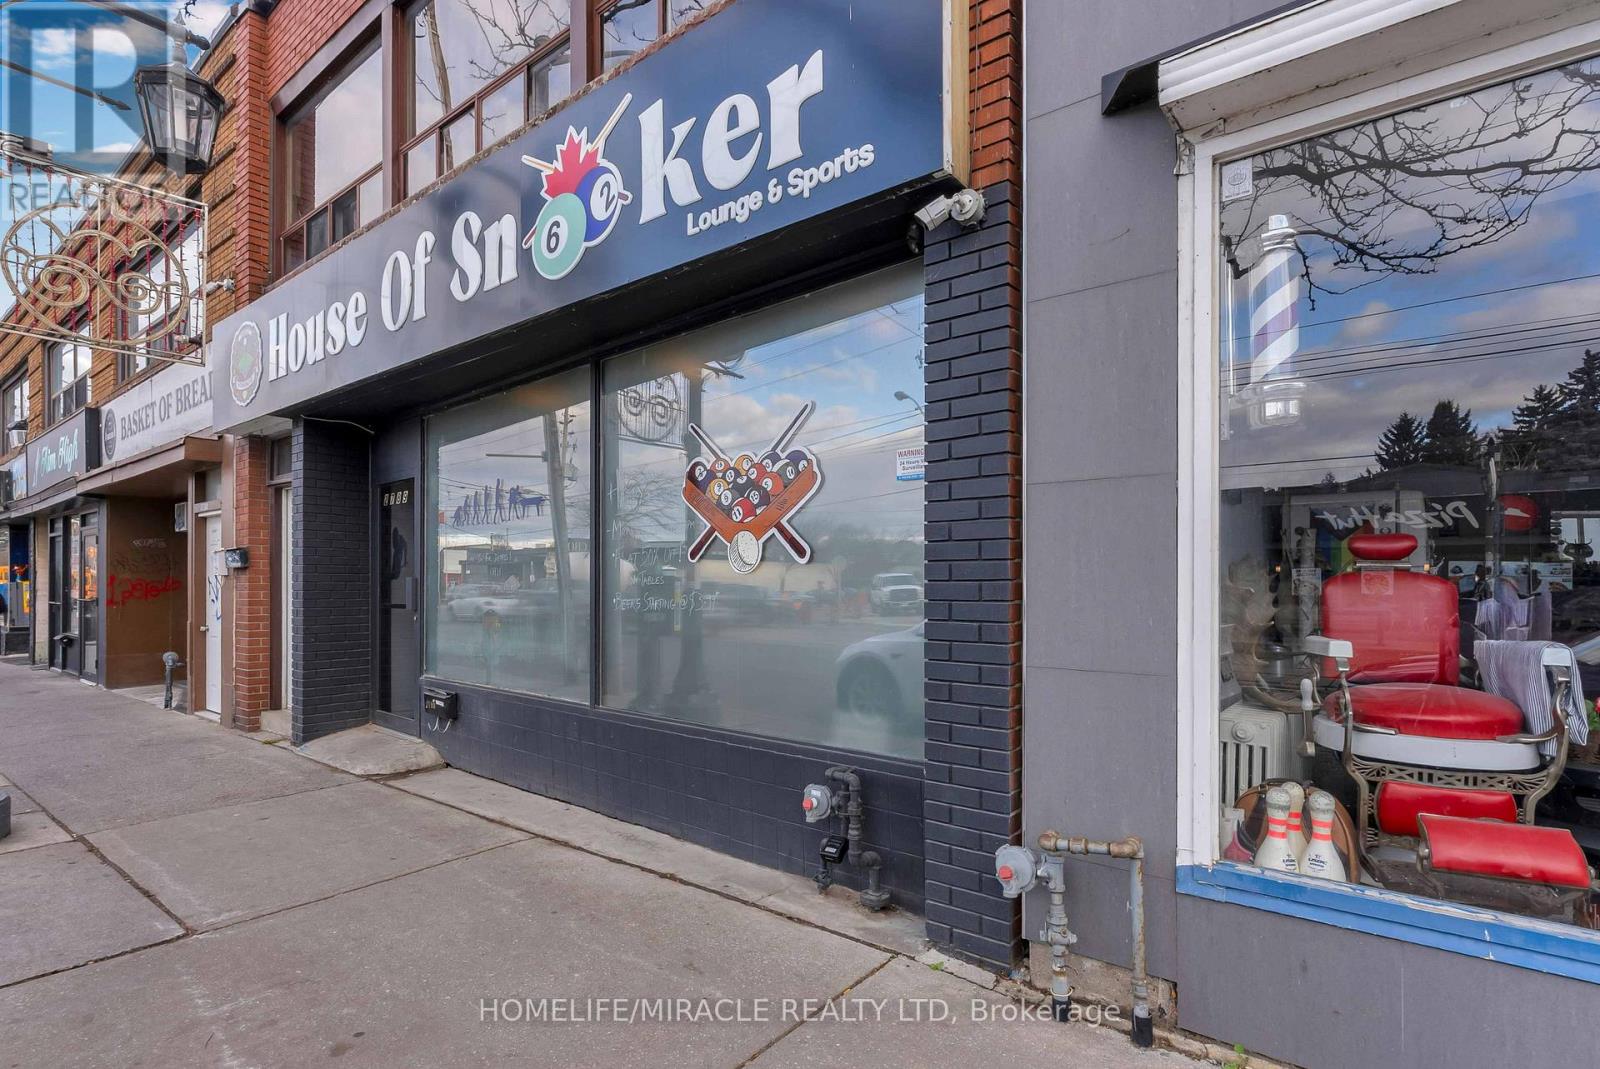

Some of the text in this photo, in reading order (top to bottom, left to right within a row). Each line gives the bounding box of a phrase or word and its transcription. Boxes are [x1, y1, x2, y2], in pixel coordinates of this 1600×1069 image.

[686, 143, 875, 236] Lounge & Sports
[268, 291, 368, 382] House
[380, 231, 437, 332] Of
[120, 400, 157, 441] BASKET
[159, 391, 173, 423] OF
